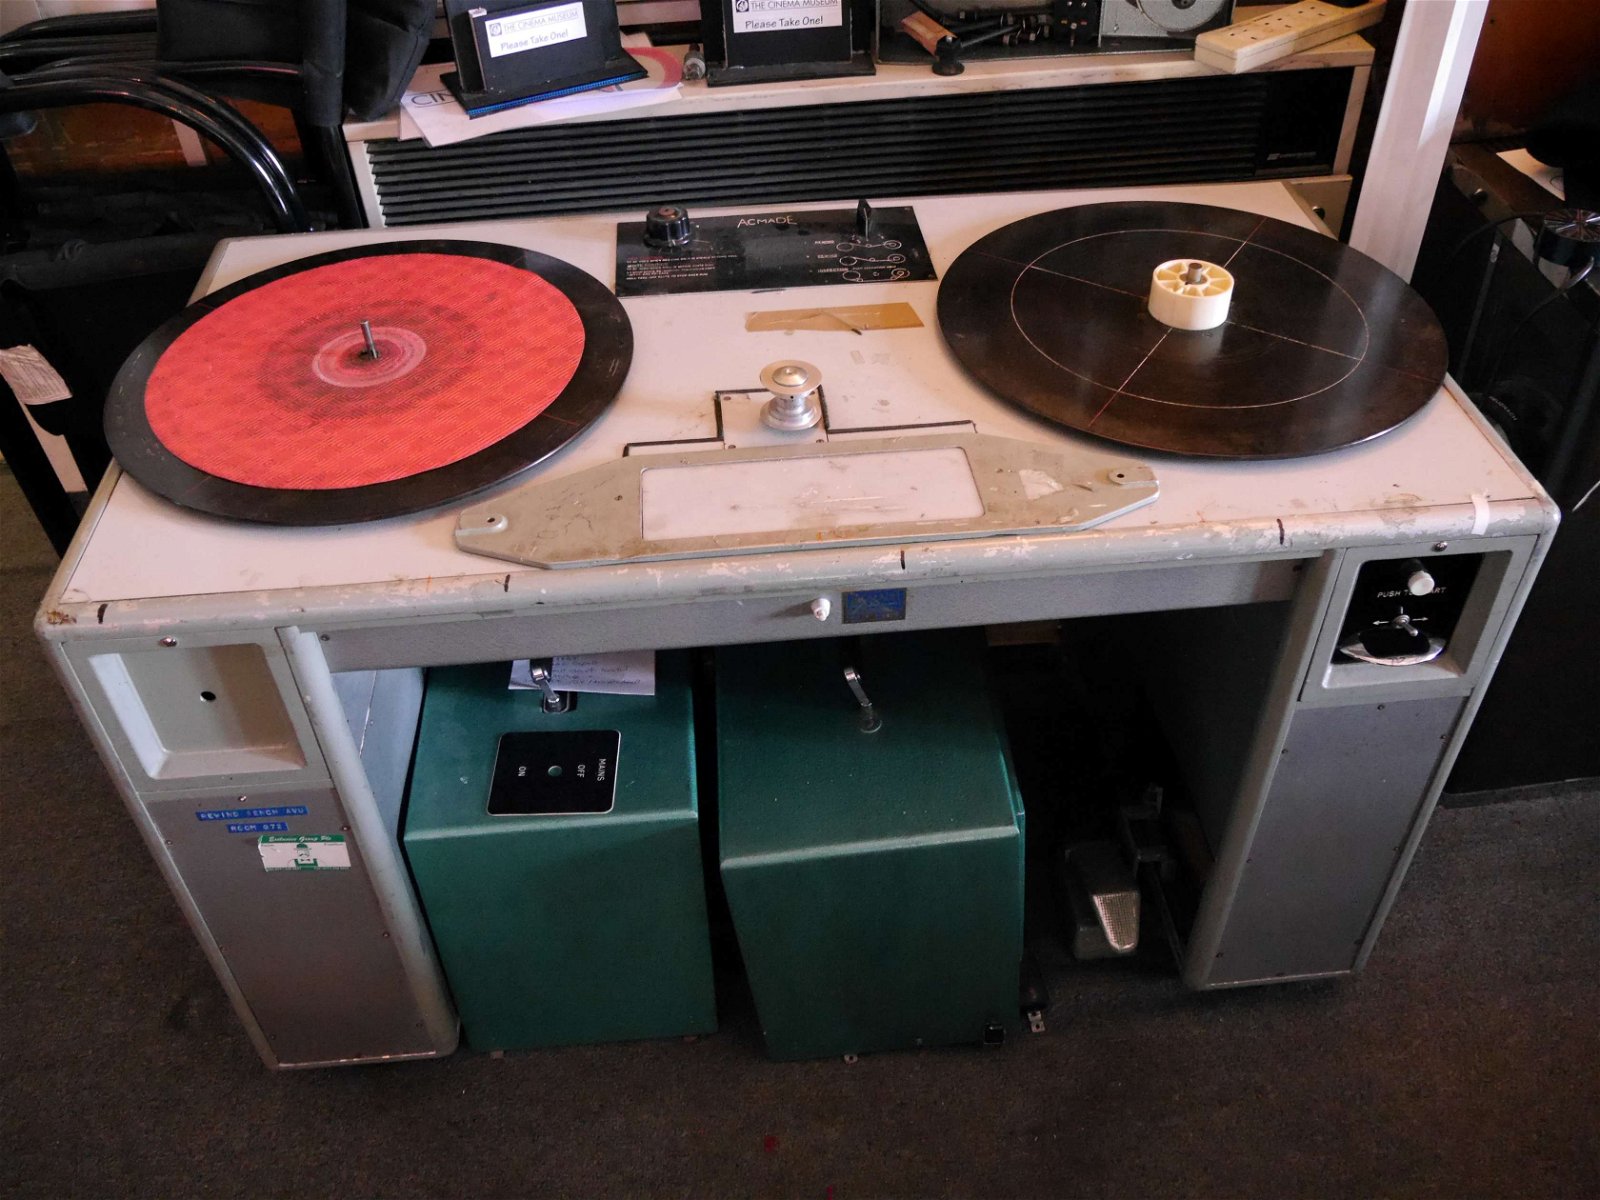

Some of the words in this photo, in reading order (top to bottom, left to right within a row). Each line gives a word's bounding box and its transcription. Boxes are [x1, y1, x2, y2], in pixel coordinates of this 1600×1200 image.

[750, 1, 765, 10] THE
[767, 0, 800, 9] CINEMA
[504, 22, 515, 32] THE
[518, 18, 546, 29] CINEMA
[548, 10, 579, 22] MUSEUM
[745, 20, 777, 29] Please
[779, 18, 800, 27] Take
[802, 16, 823, 25] One!
[500, 39, 529, 51] Please
[530, 35, 549, 45] Take
[550, 29, 568, 40] One!
[737, 216, 797, 229] ACMADE
[1377, 590, 1401, 598] PUSH
[518, 766, 527, 777] ON
[577, 764, 585, 778] OFF
[597, 758, 606, 781] MAINS
